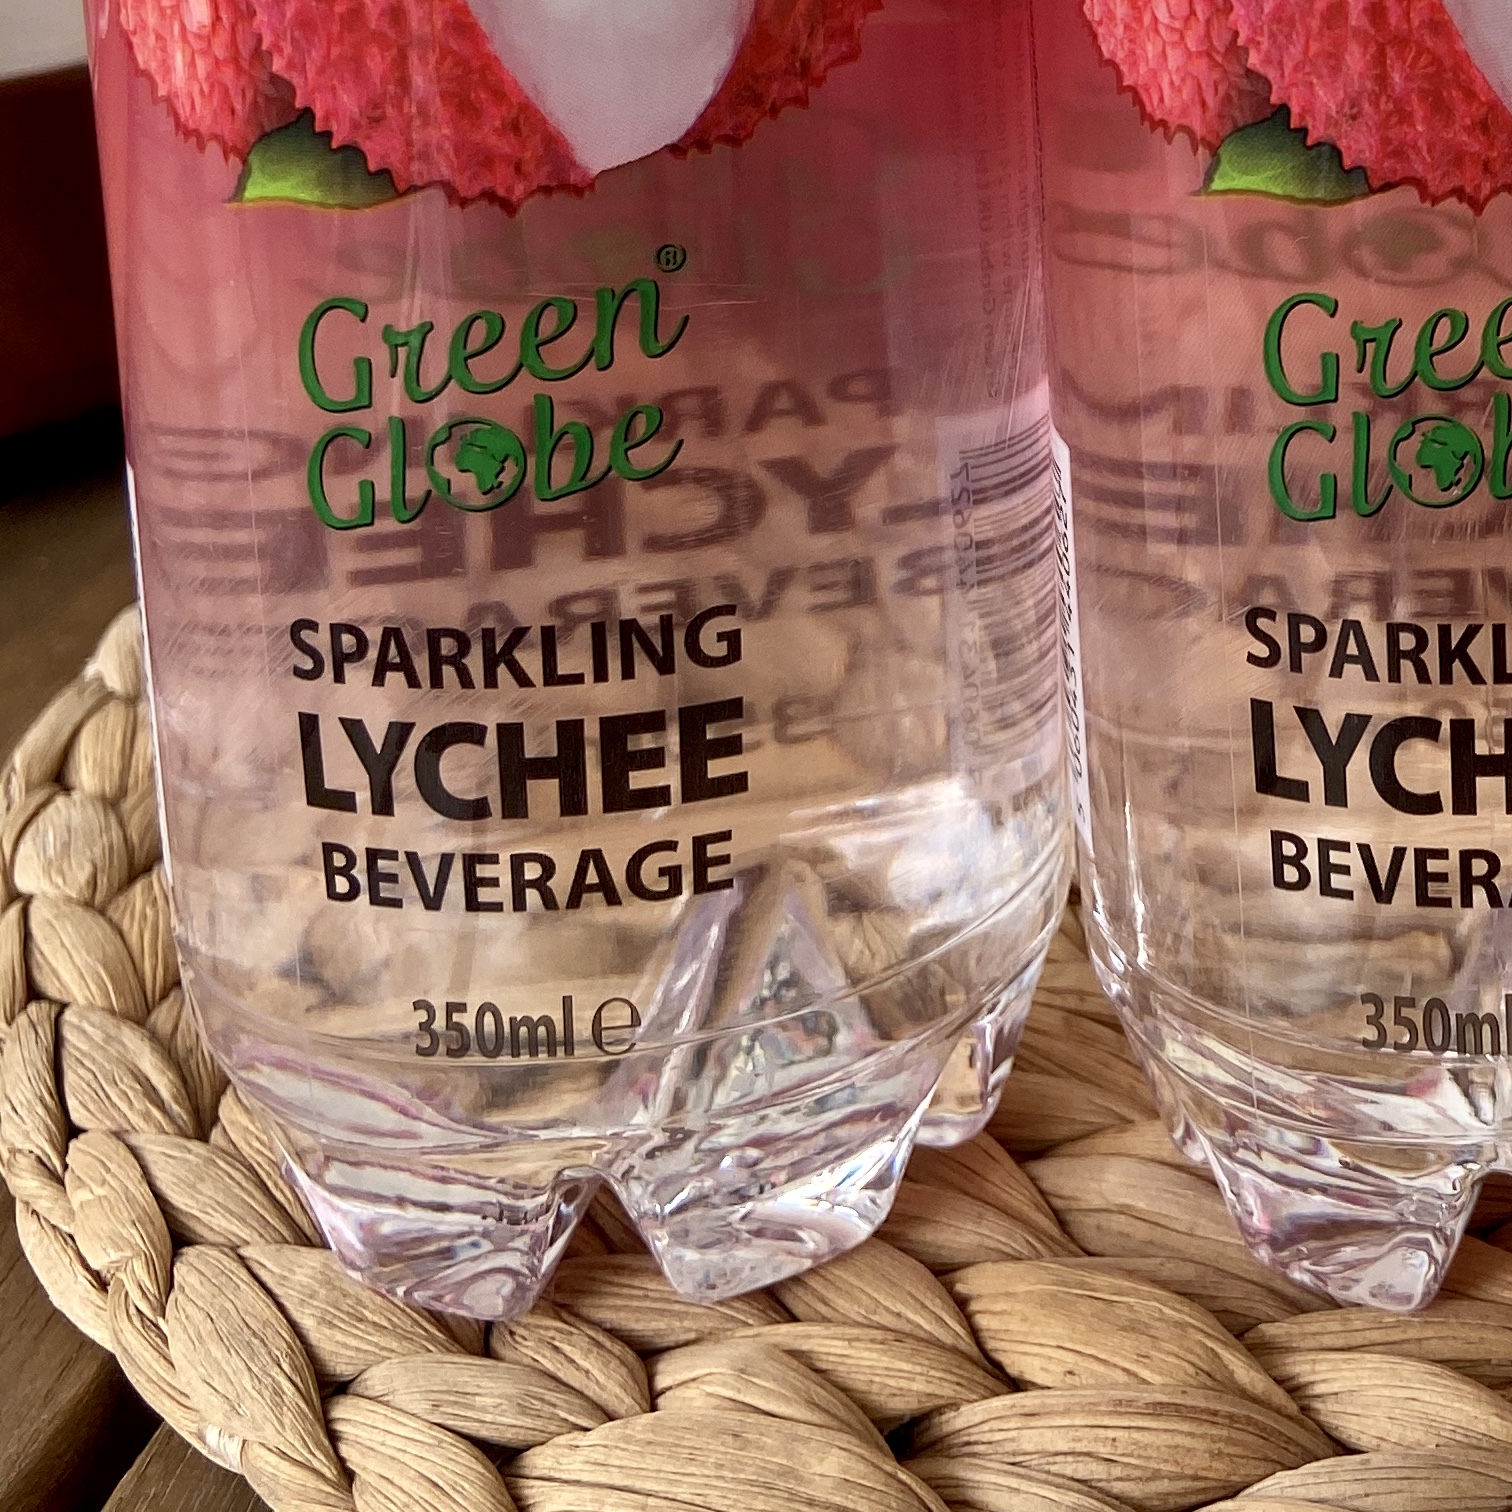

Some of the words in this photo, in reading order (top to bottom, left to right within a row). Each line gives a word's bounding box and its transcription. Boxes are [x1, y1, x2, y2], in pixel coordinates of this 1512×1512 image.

[297, 274, 690, 415] Green
[306, 393, 686, 530] Globe
[289, 603, 744, 690] SPARKLING
[295, 696, 751, 821] LYCHEE
[321, 829, 736, 913] BEVERAGE
[411, 993, 576, 1059] 350ml
